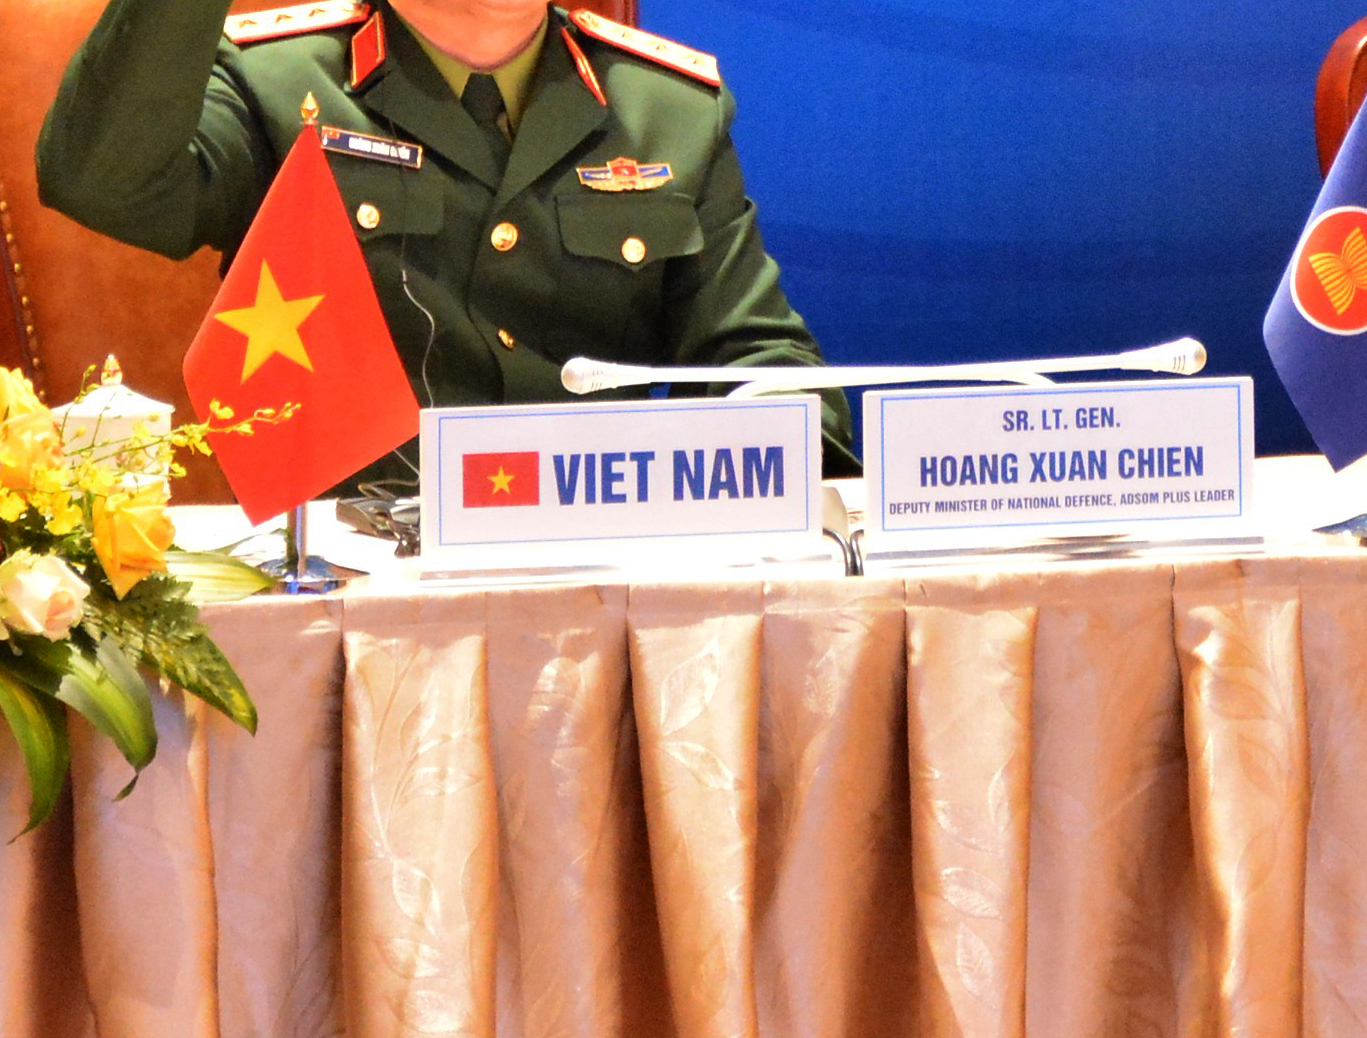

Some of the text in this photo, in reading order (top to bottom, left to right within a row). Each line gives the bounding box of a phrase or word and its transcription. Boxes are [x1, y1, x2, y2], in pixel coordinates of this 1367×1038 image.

[1003, 407, 1120, 431] SR. LT. GEN.
[553, 446, 784, 505] VIET NAM
[920, 446, 1203, 487] HOANG XUAN CHIEN
[890, 502, 930, 514] DEPUTY
[935, 499, 987, 512] MINISTER
[991, 499, 1003, 510] OF
[1008, 497, 1061, 509] NATIONAL
[1120, 492, 1159, 504] ADSOM
[1163, 491, 1190, 503] PLUS
[1194, 489, 1234, 502] LEADER
